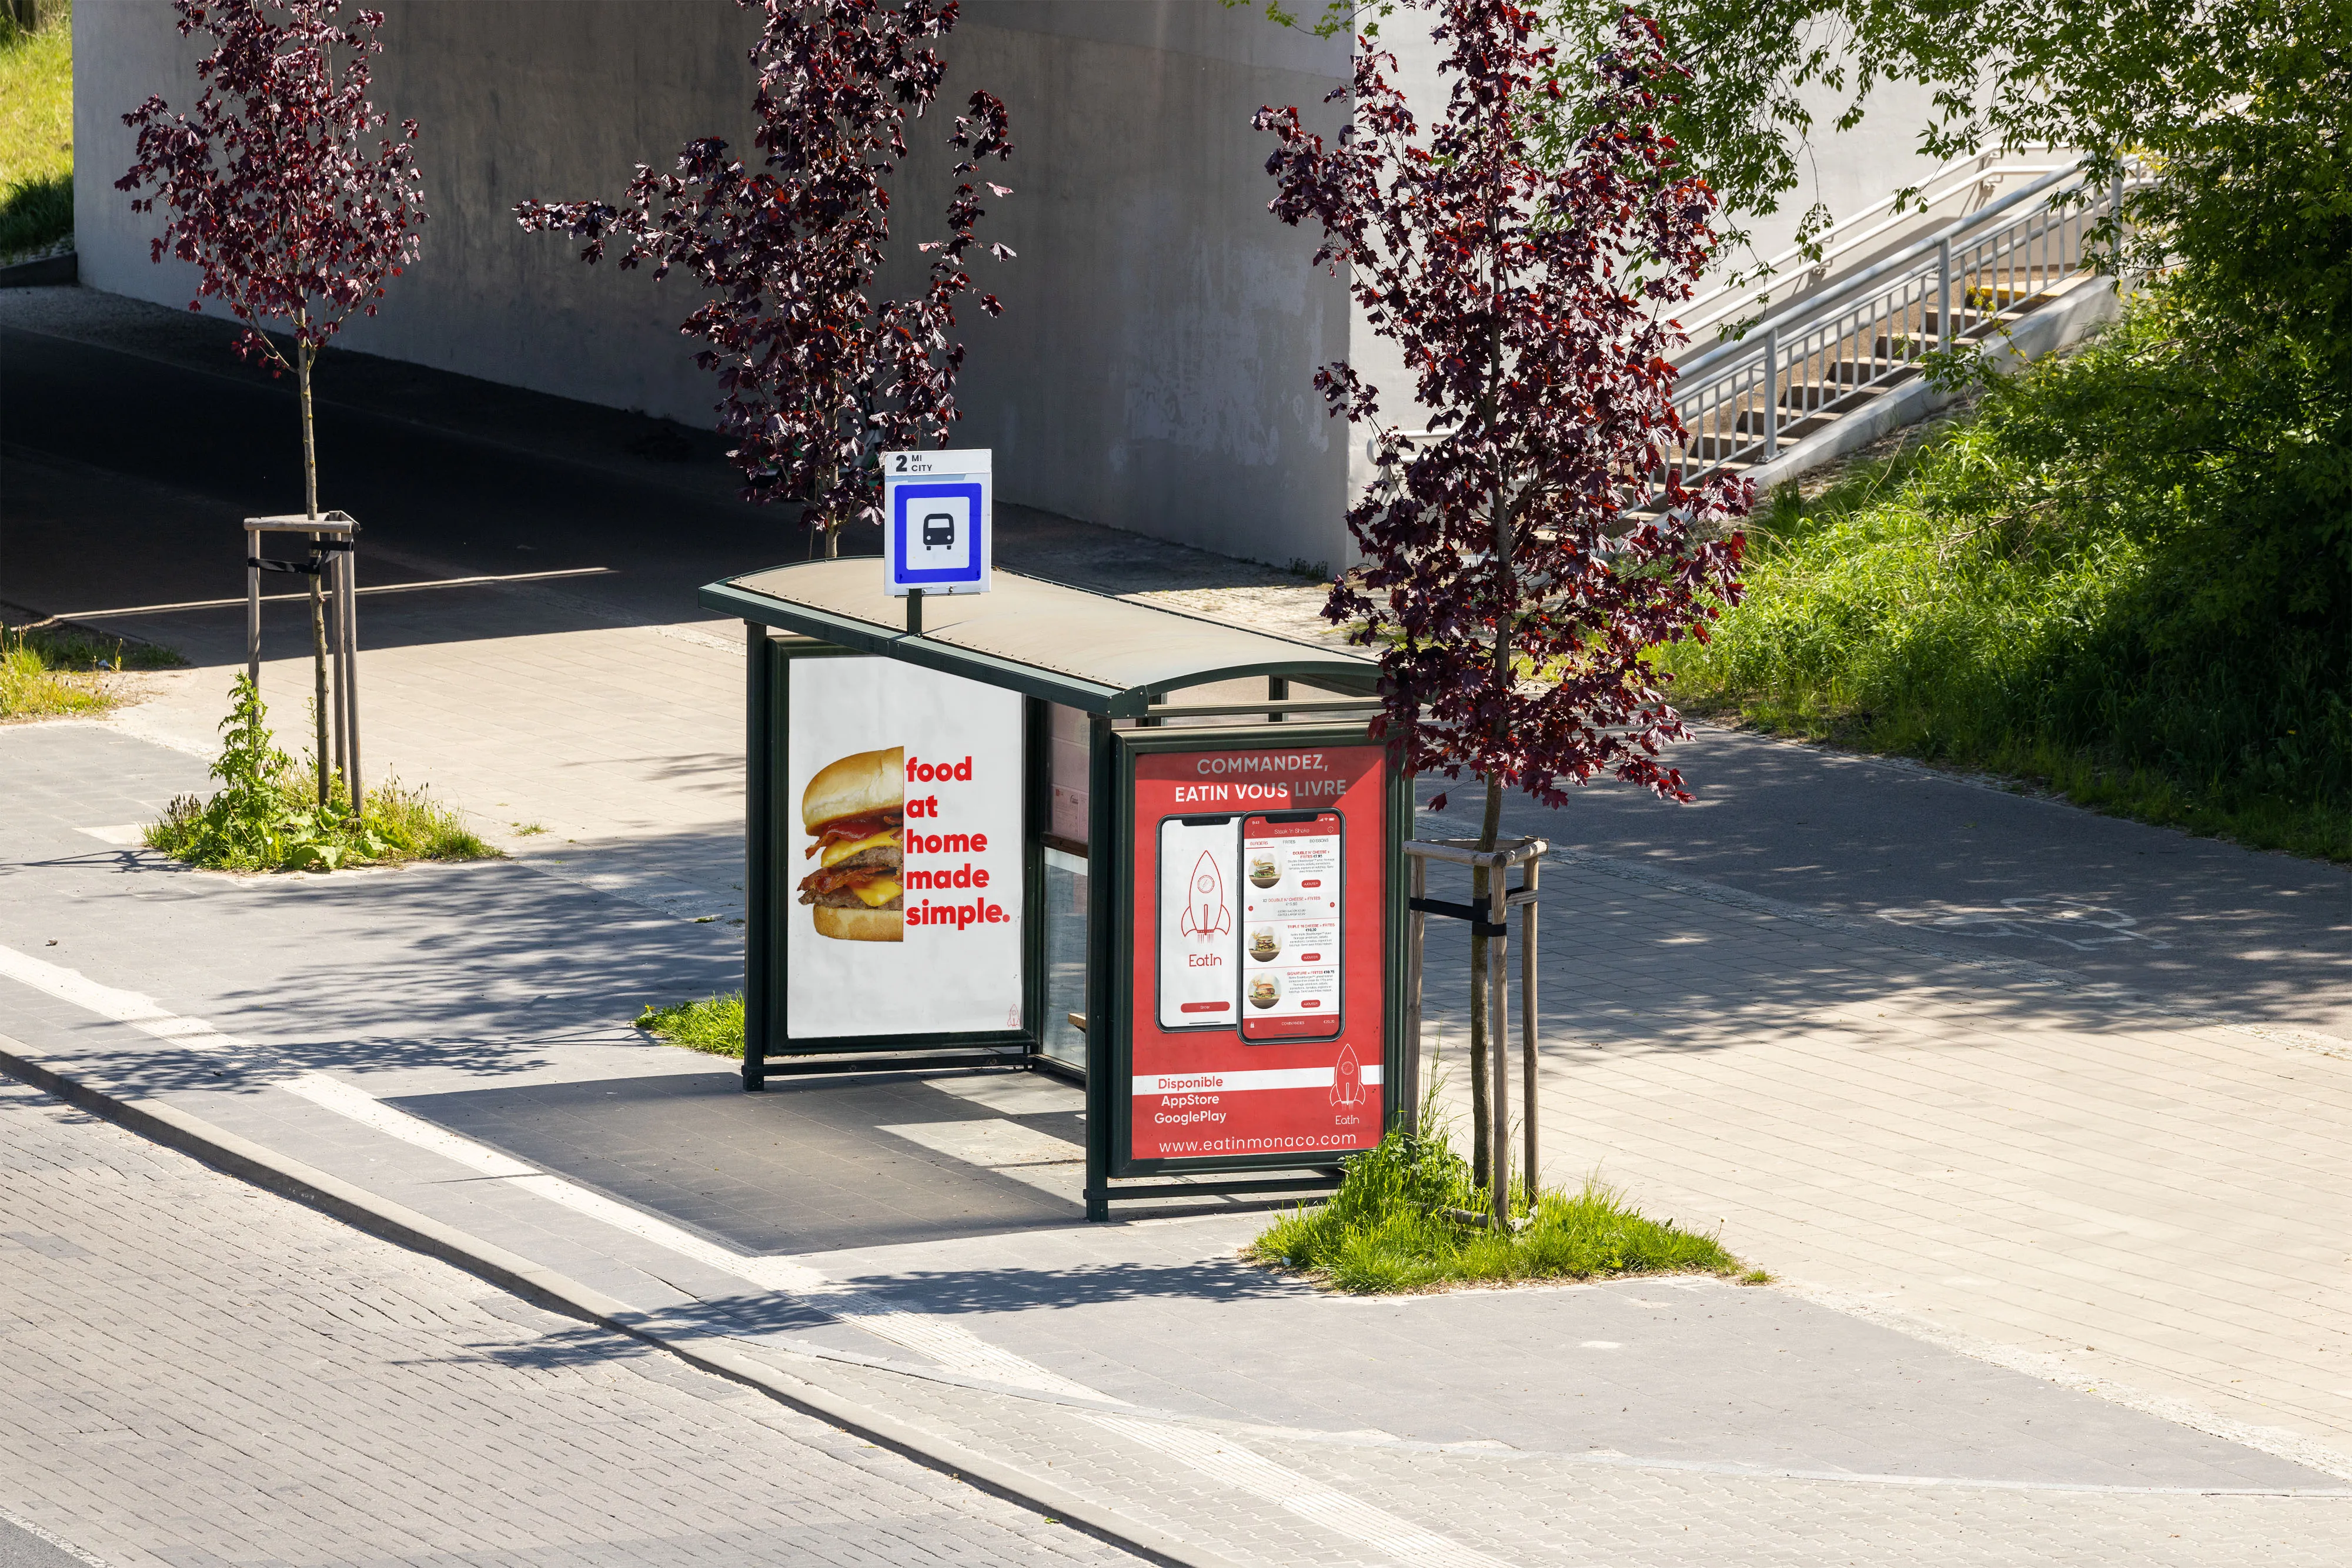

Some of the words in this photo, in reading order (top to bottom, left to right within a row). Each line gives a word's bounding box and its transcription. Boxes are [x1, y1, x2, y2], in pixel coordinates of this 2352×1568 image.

[896, 455, 907, 472] 2
[906, 756, 972, 782] food
[1197, 754, 1328, 774] COMMANDEZ,
[1176, 785, 1228, 802] EATIN
[1235, 783, 1288, 800] VOUS
[1295, 780, 1346, 797] LIVRE
[906, 795, 938, 818] at
[907, 829, 988, 854] home
[907, 863, 990, 890] made
[906, 897, 1010, 930] simple.
[1189, 954, 1222, 967] EatIn
[1158, 1076, 1223, 1091] Disponible
[1161, 1094, 1220, 1108] AppStore
[1154, 1109, 1227, 1125] GooglePlay
[1335, 1115, 1359, 1125] EatIn
[1159, 1134, 1357, 1153] www.eatinmonaco.com
